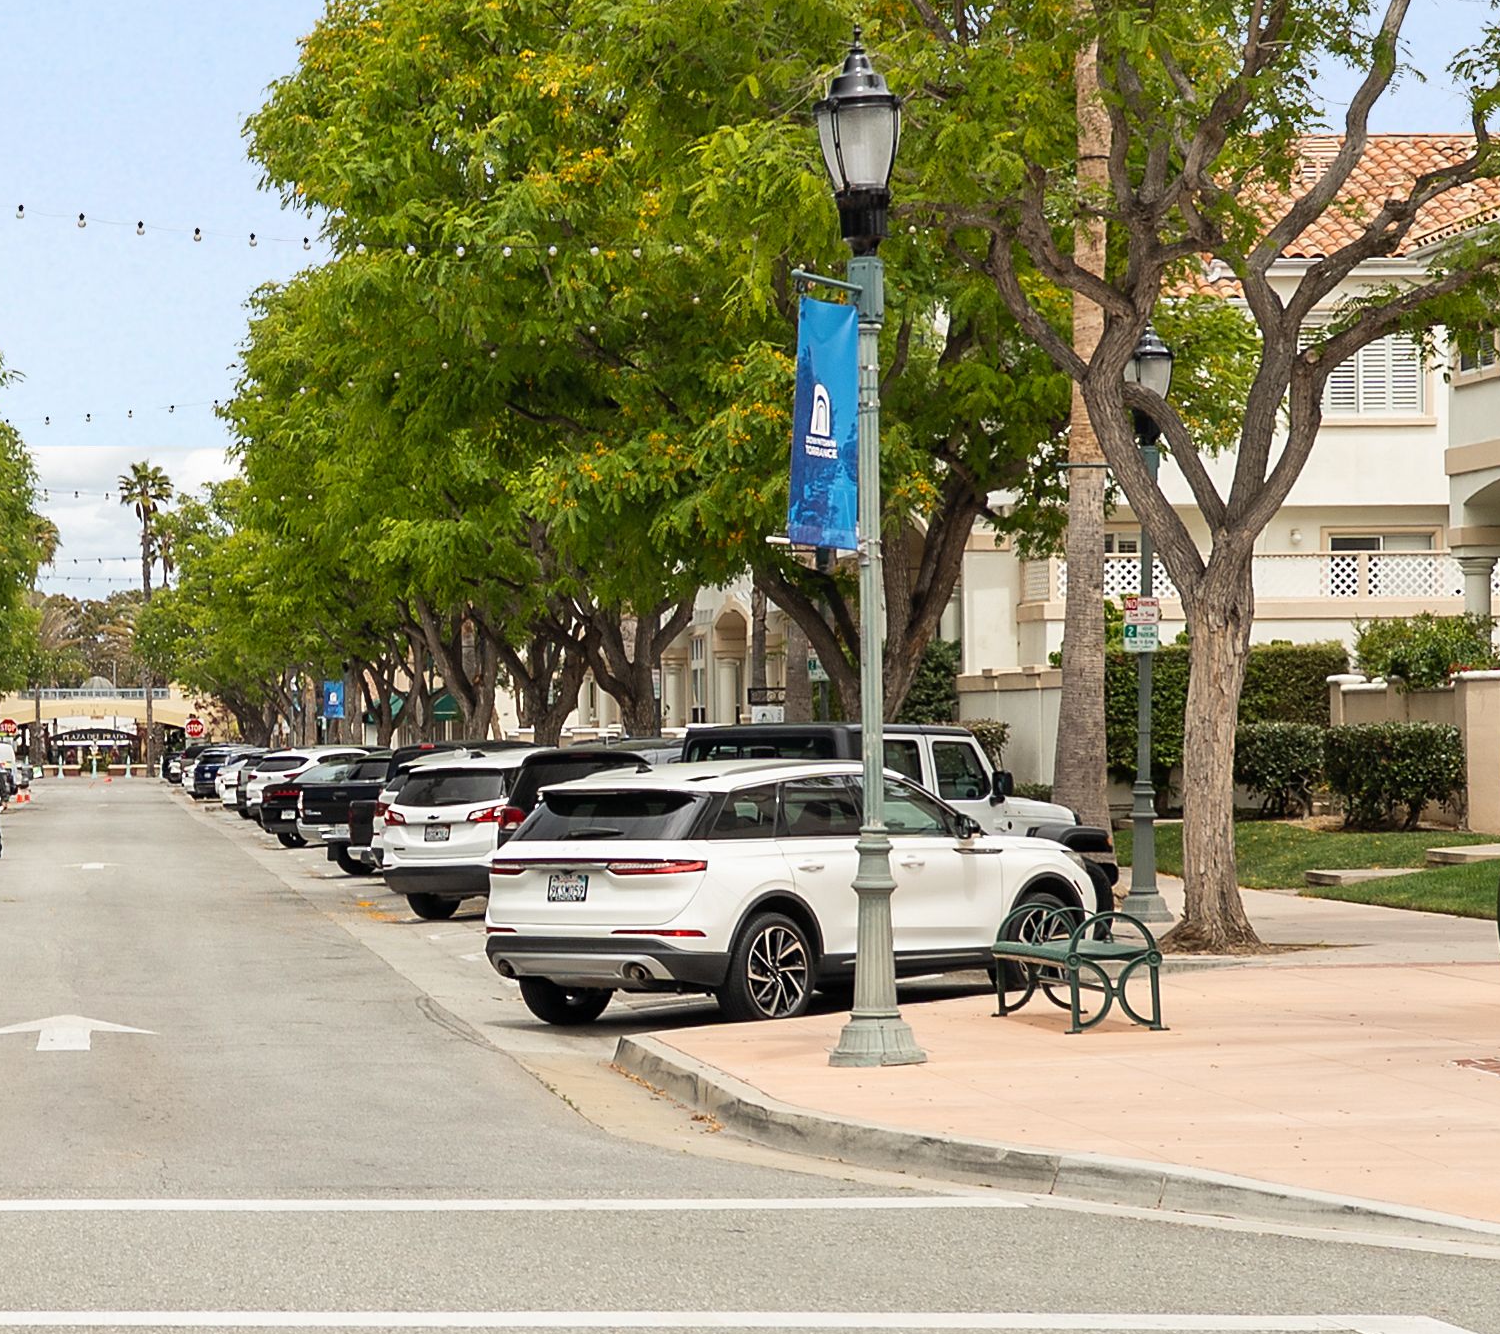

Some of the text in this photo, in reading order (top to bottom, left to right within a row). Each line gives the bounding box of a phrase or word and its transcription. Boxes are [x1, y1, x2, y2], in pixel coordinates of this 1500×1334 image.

[805, 435, 837, 448] DOWNTOWN
[805, 444, 838, 459] TORRANCE
[1125, 599, 1137, 609] NO
[1127, 626, 1134, 637] 2
[0, 723, 16, 732] STOP
[187, 724, 203, 732] STOP
